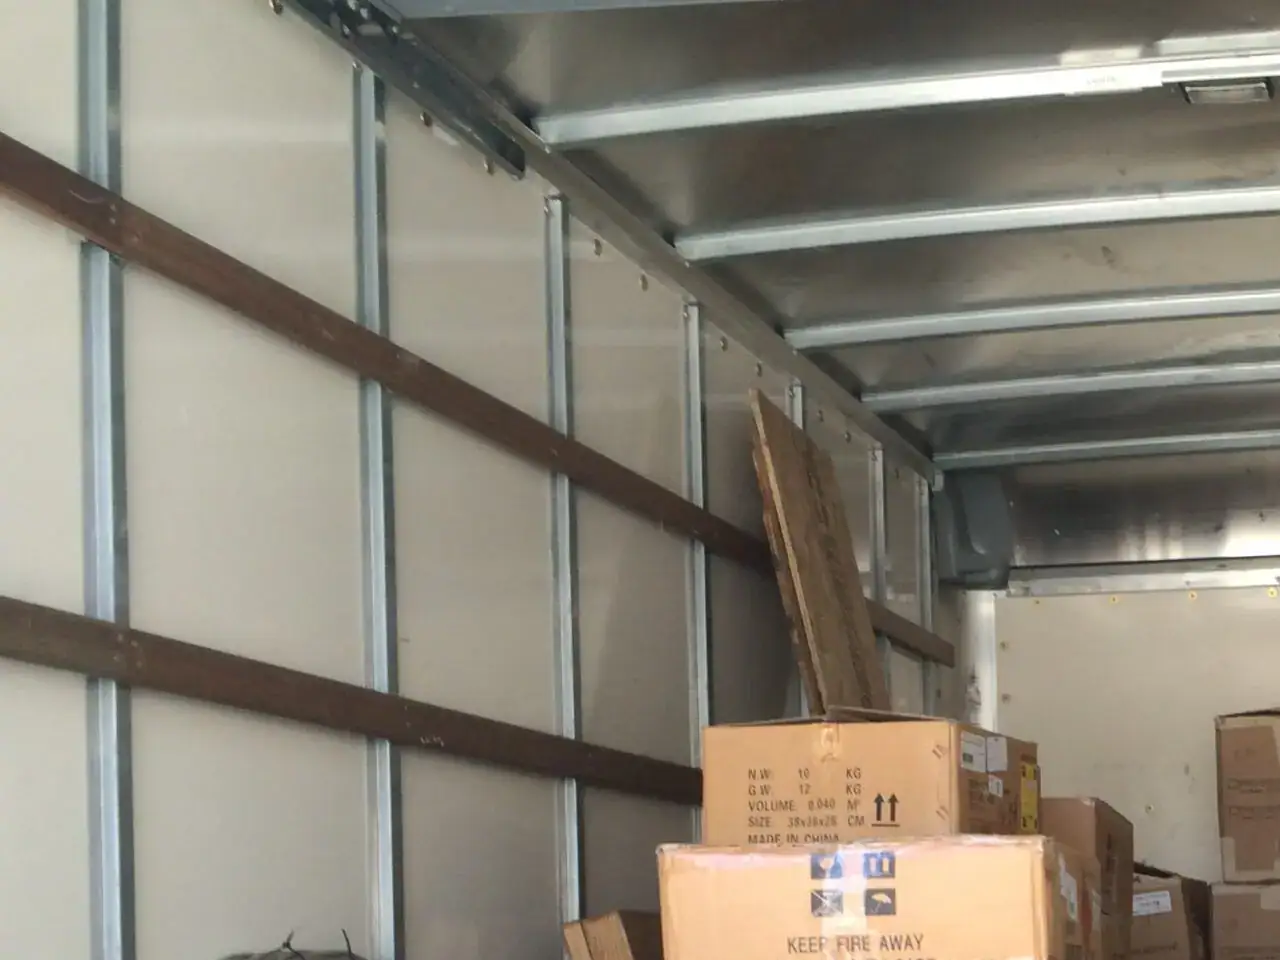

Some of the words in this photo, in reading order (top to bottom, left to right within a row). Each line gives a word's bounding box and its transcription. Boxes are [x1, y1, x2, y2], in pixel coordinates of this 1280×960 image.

[846, 768, 861, 779] KG
[846, 784, 861, 795] KG
[847, 815, 865, 827] CM
[748, 834, 781, 844] MADE
[786, 834, 799, 844] IN
[804, 833, 840, 843] CHINA
[787, 935, 828, 954] KEEP
[836, 934, 871, 953] FIRE
[879, 933, 924, 952] AWAY
